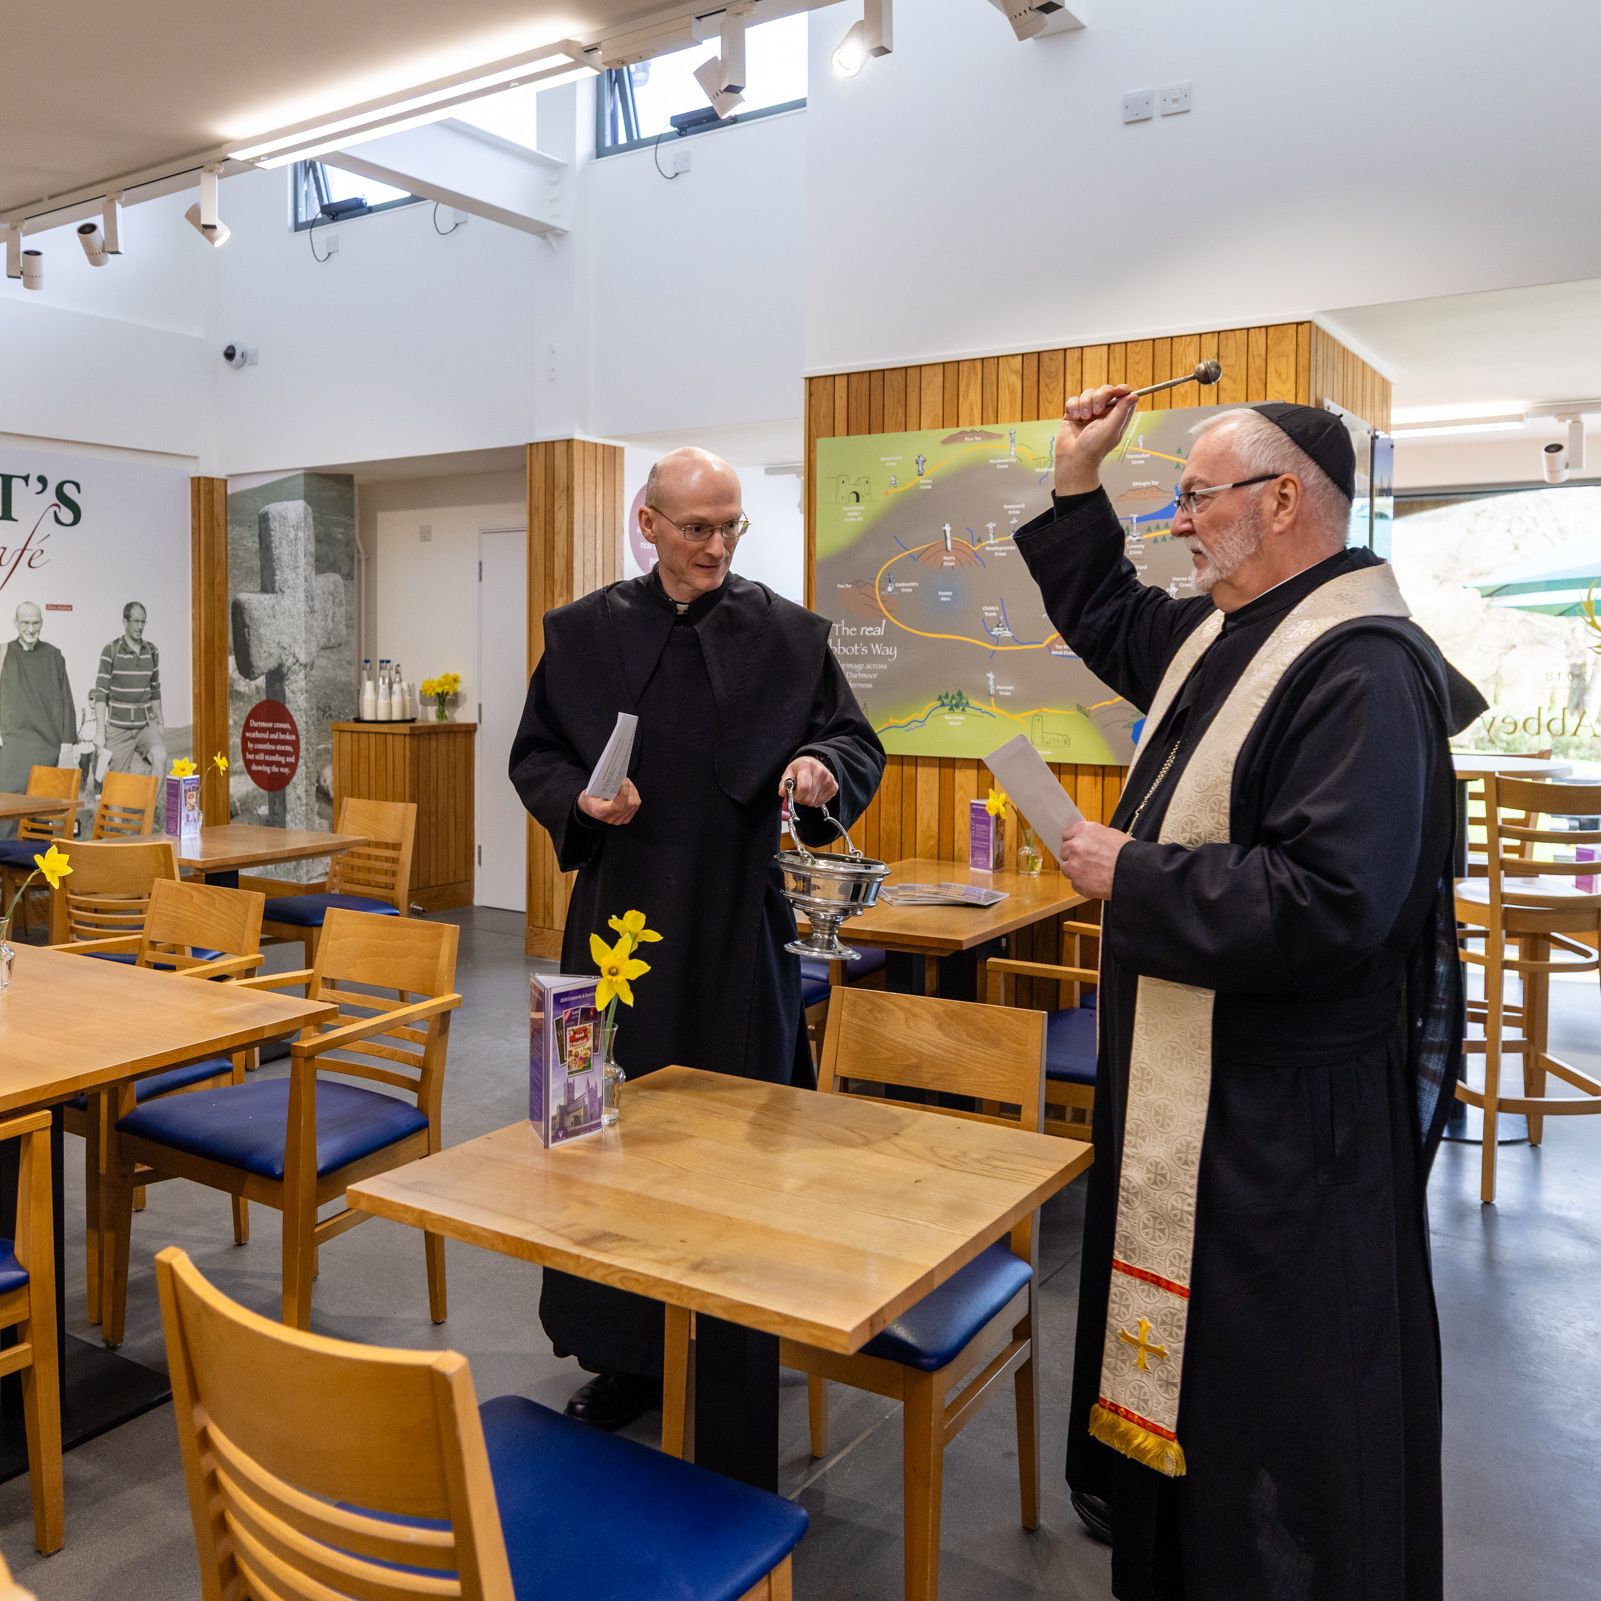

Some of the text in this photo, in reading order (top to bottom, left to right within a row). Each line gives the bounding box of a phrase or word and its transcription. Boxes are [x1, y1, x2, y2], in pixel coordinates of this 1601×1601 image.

[832, 619, 886, 636] The real
[829, 638, 898, 662] bbot's Way
[846, 671, 879, 679] Dartmoor
[250, 720, 273, 728] Dartmoor
[269, 731, 279, 739] and
[279, 732, 296, 740] broken
[247, 741, 293, 752] by countless storms,
[255, 752, 264, 760] still
[265, 753, 285, 764] standing
[286, 755, 295, 763] and
[251, 763, 290, 775] showing the way.
